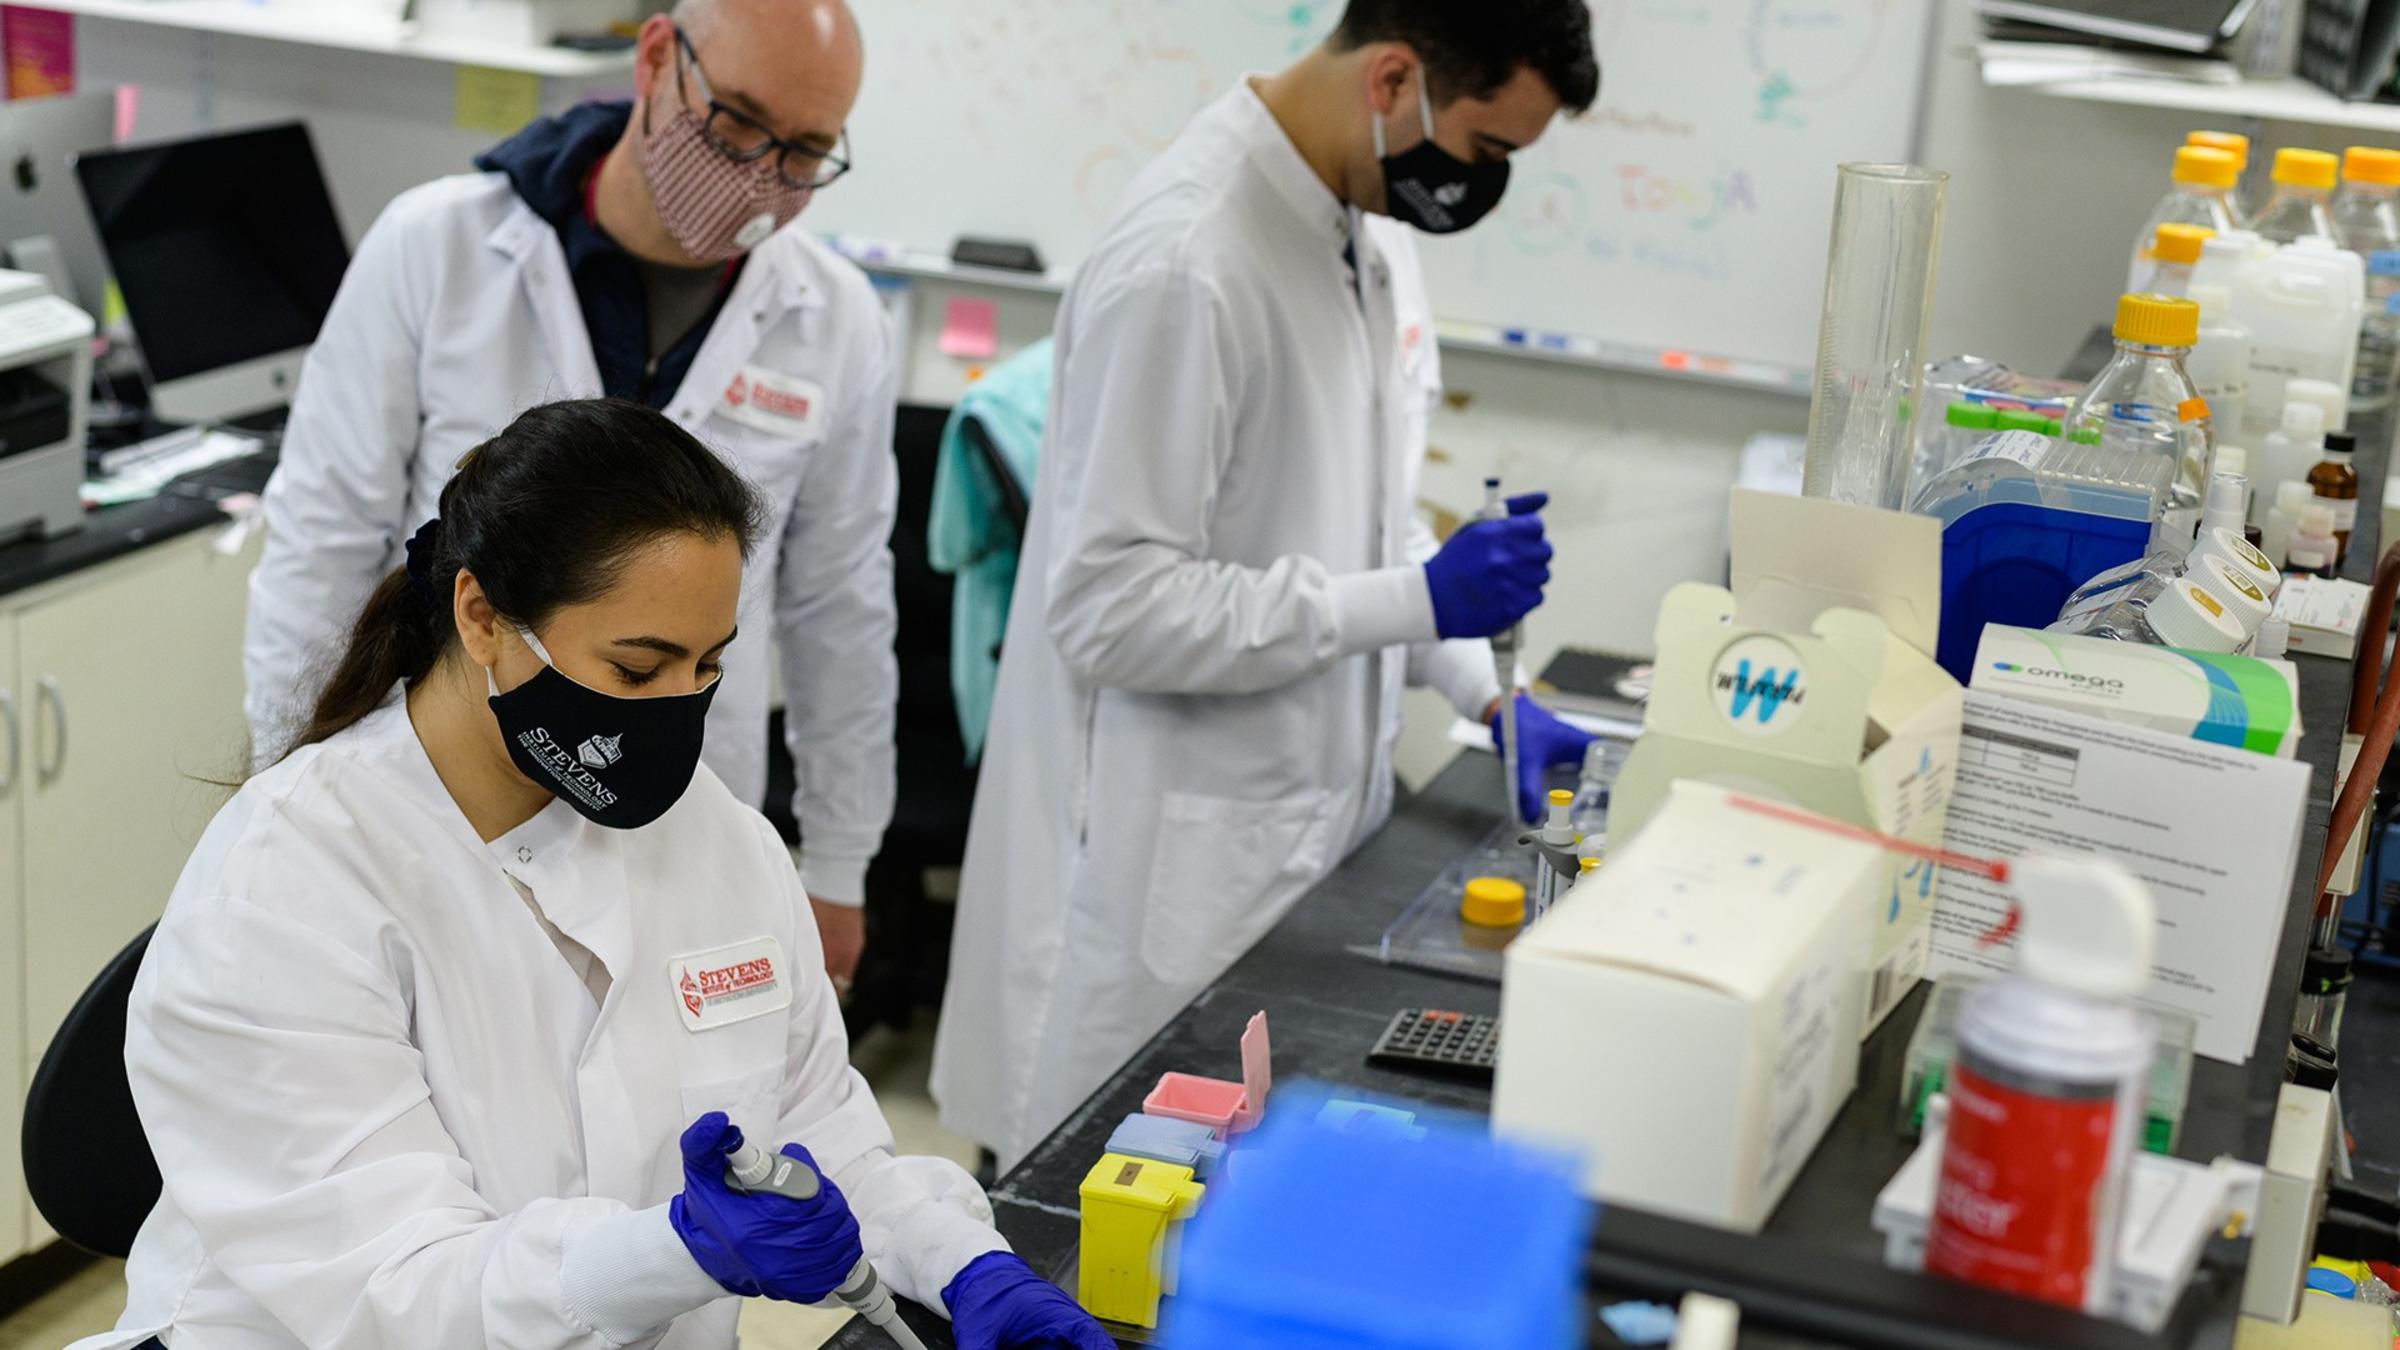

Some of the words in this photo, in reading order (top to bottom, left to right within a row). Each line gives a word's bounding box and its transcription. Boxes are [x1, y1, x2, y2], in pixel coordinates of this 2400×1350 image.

[2027, 667, 2124, 688] omega
[522, 731, 556, 767] INSTITUTE
[563, 770, 608, 809] TECHNOLOGY
[527, 746, 562, 782] INNOVATION
[530, 726, 618, 805] STEVENS
[698, 957, 771, 986] STEVENS
